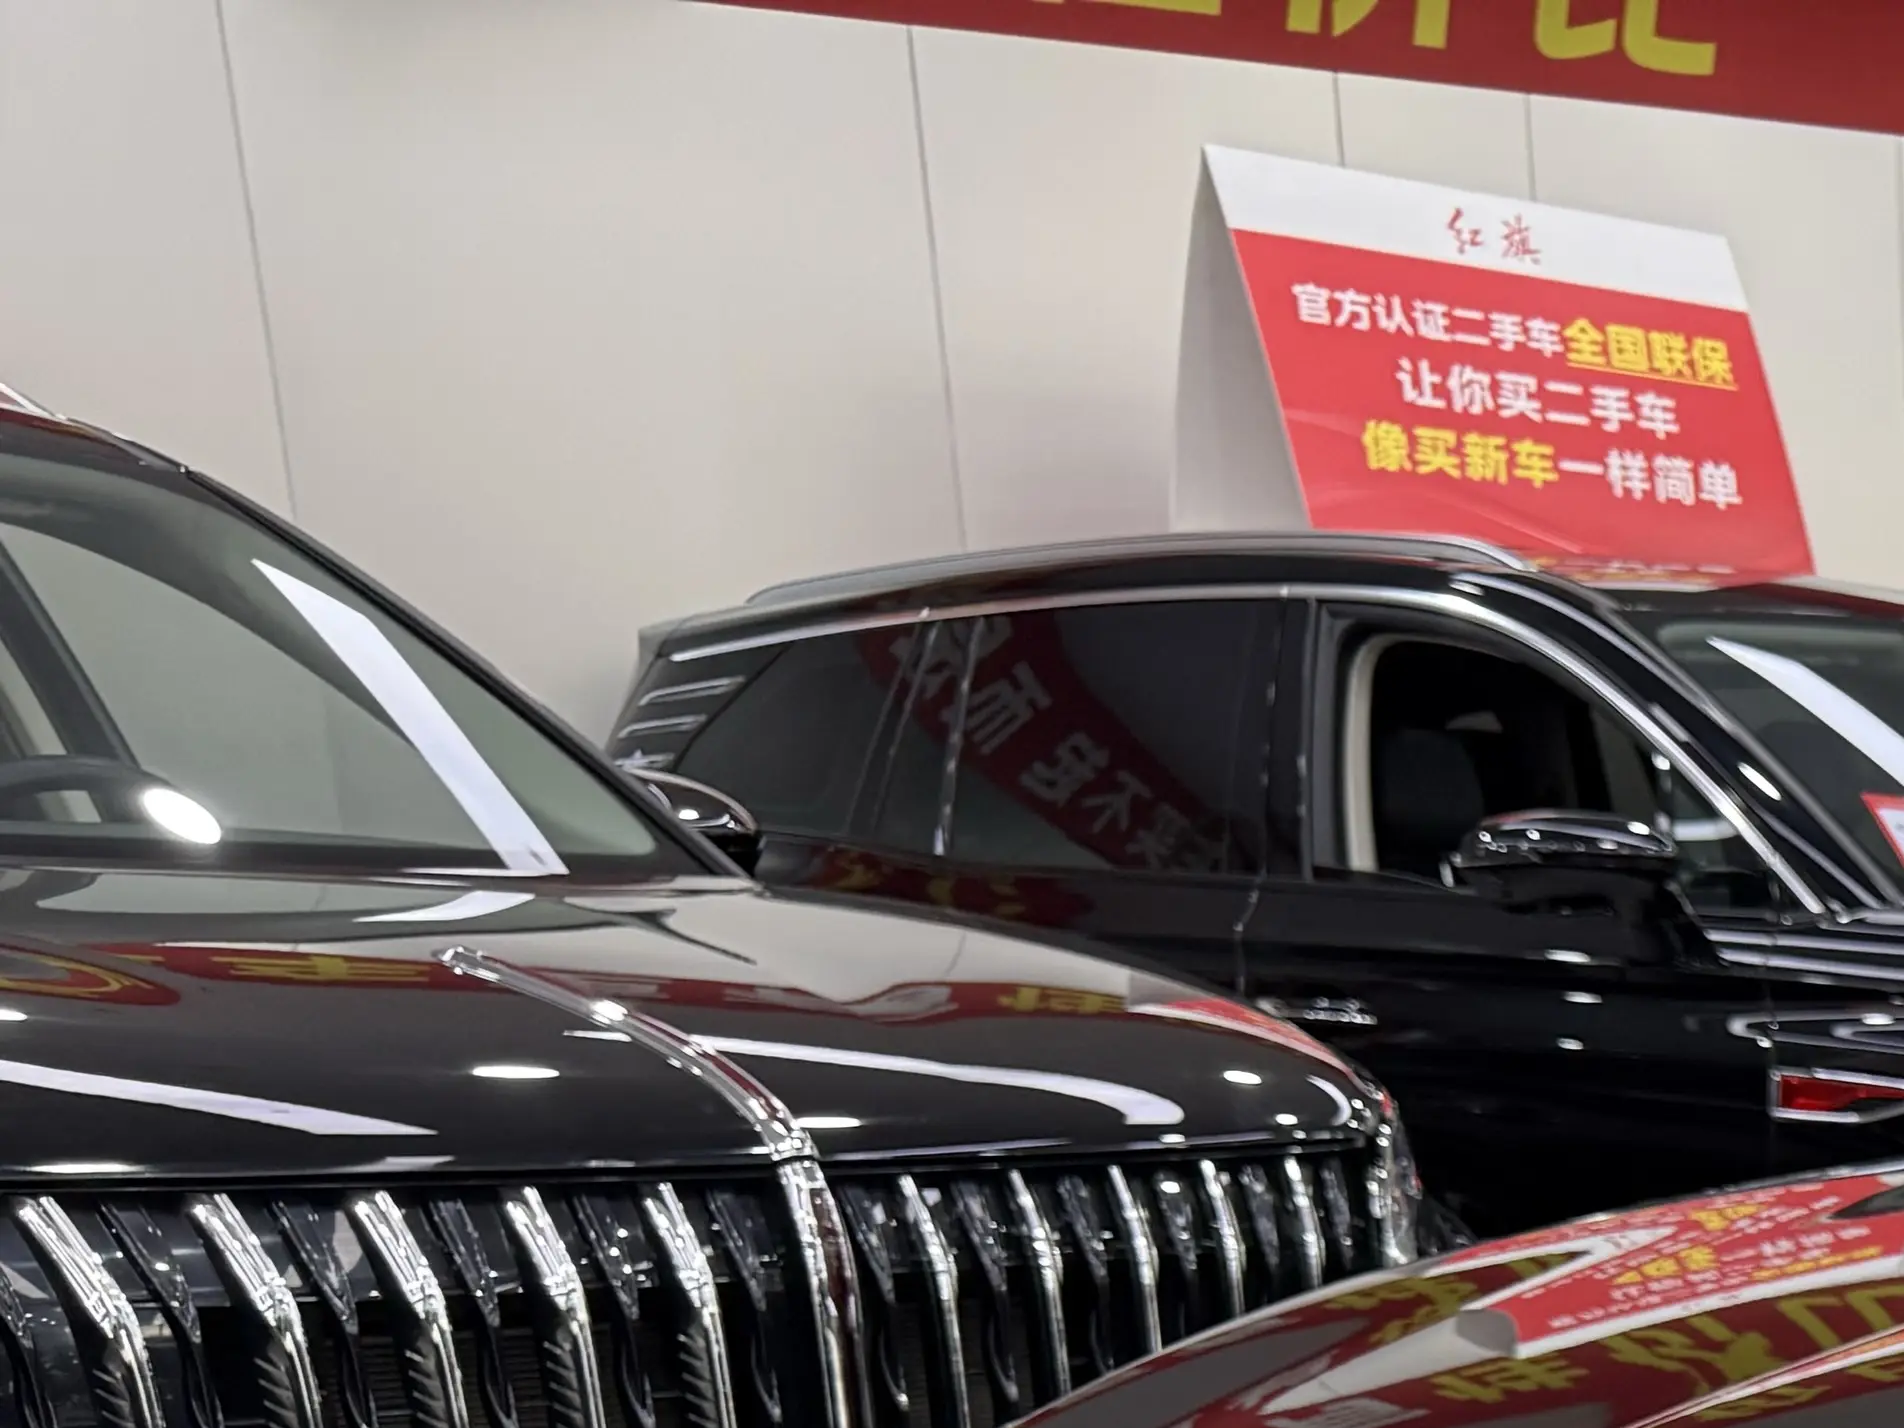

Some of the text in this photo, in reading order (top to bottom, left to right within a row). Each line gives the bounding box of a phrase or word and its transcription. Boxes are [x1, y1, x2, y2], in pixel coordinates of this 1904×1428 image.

[1447, 207, 1542, 265] 红旗
[1290, 282, 1735, 383] 官方认证二手车全国联保
[1396, 357, 1679, 439] 让你买二手车
[1361, 420, 1742, 509] 像买新车一样简单
